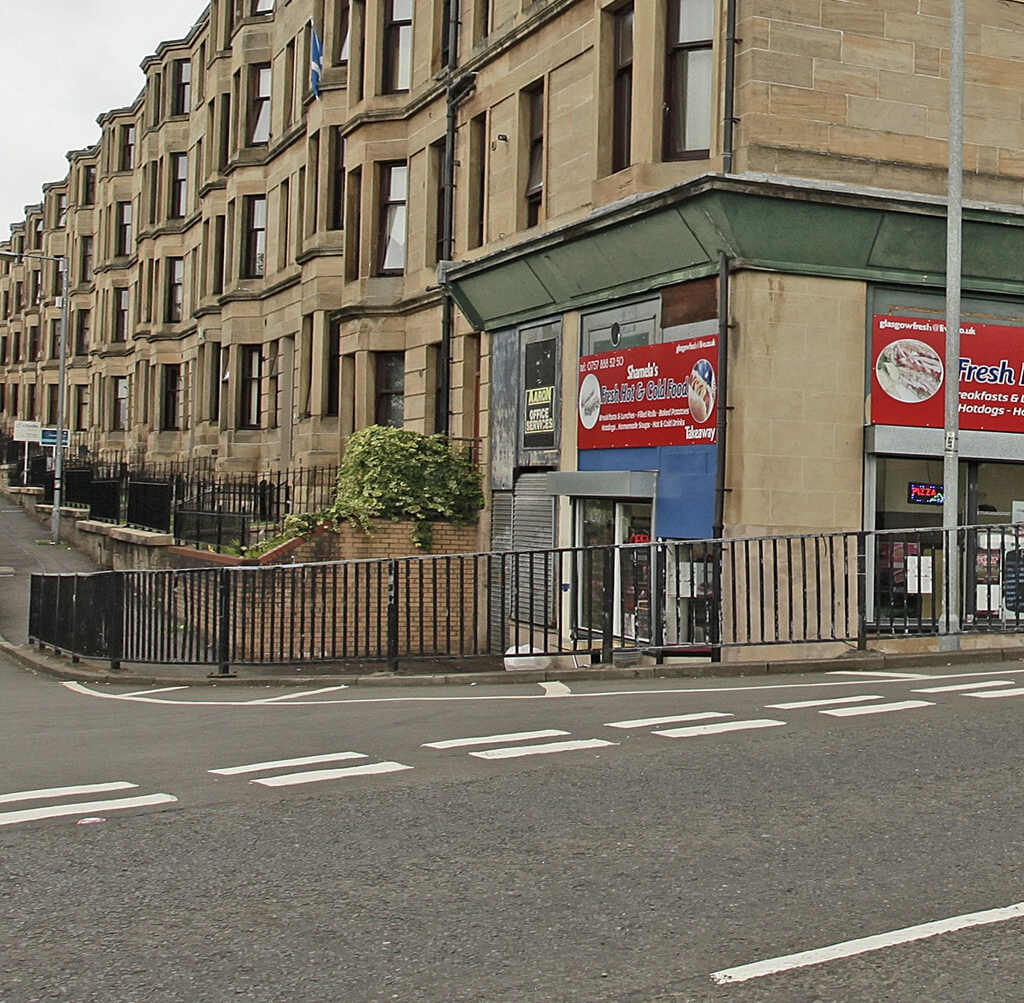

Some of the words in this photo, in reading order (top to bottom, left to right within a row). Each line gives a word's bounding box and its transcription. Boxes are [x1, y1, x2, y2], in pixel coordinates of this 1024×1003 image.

[627, 362, 658, 380] Shamela's
[958, 357, 1015, 386] Fresh
[529, 387, 551, 403] AARON
[600, 383, 620, 404] Fresh
[620, 383, 635, 402] Hot
[646, 378, 666, 400] Cold
[666, 376, 689, 398] Food
[529, 408, 550, 420] OFFICE
[958, 403, 1005, 417] Hotdogs
[526, 418, 553, 431] SERVICES
[684, 425, 715, 442] Takeaway
[912, 487, 937, 496] PIZZA
